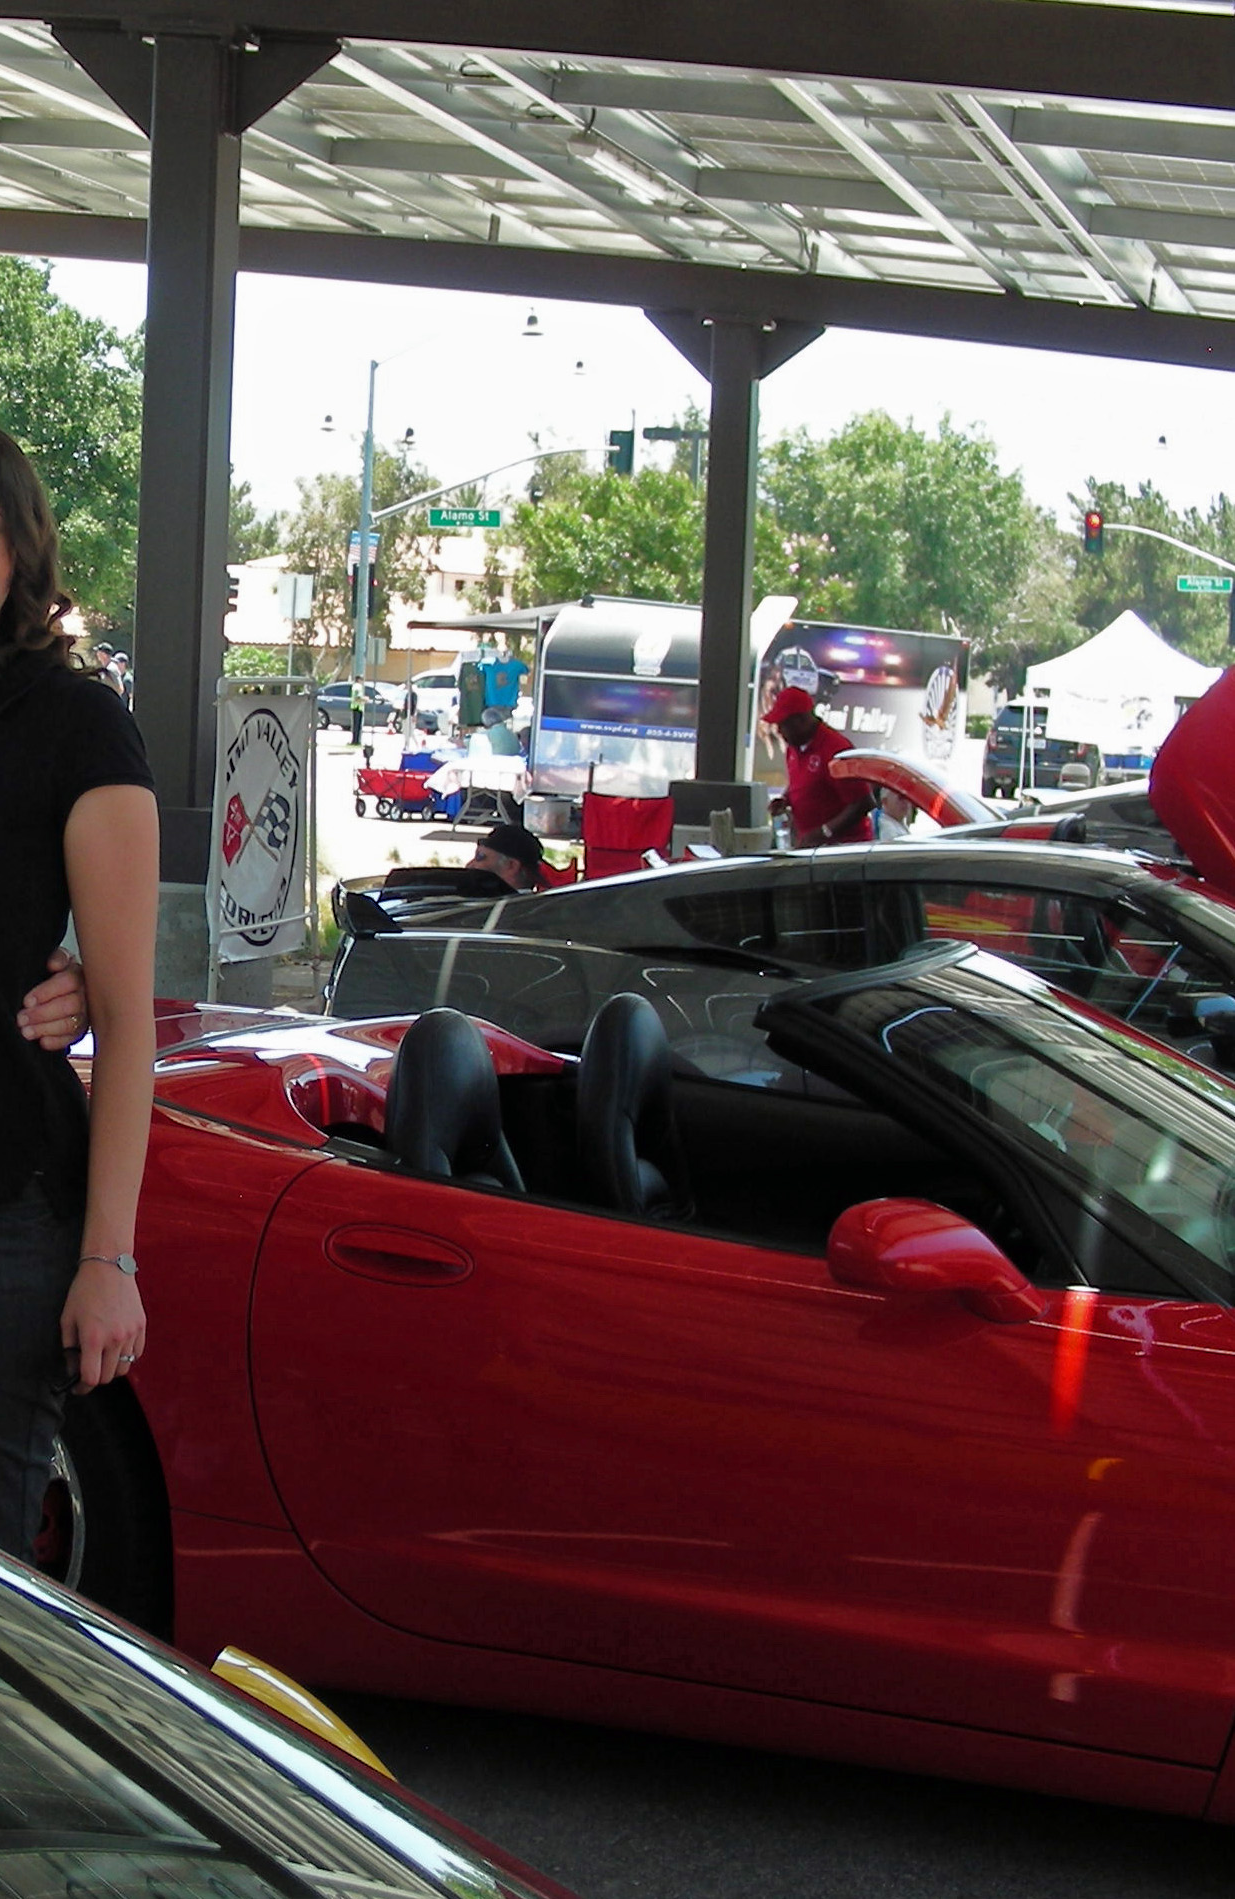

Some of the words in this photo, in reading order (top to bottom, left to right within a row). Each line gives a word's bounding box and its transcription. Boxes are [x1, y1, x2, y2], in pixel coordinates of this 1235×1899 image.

[440, 510, 475, 521] Alamo
[478, 510, 490, 521] St
[814, 703, 849, 731] Simi
[851, 706, 897, 738] Valley
[257, 719, 298, 789] VALLEY
